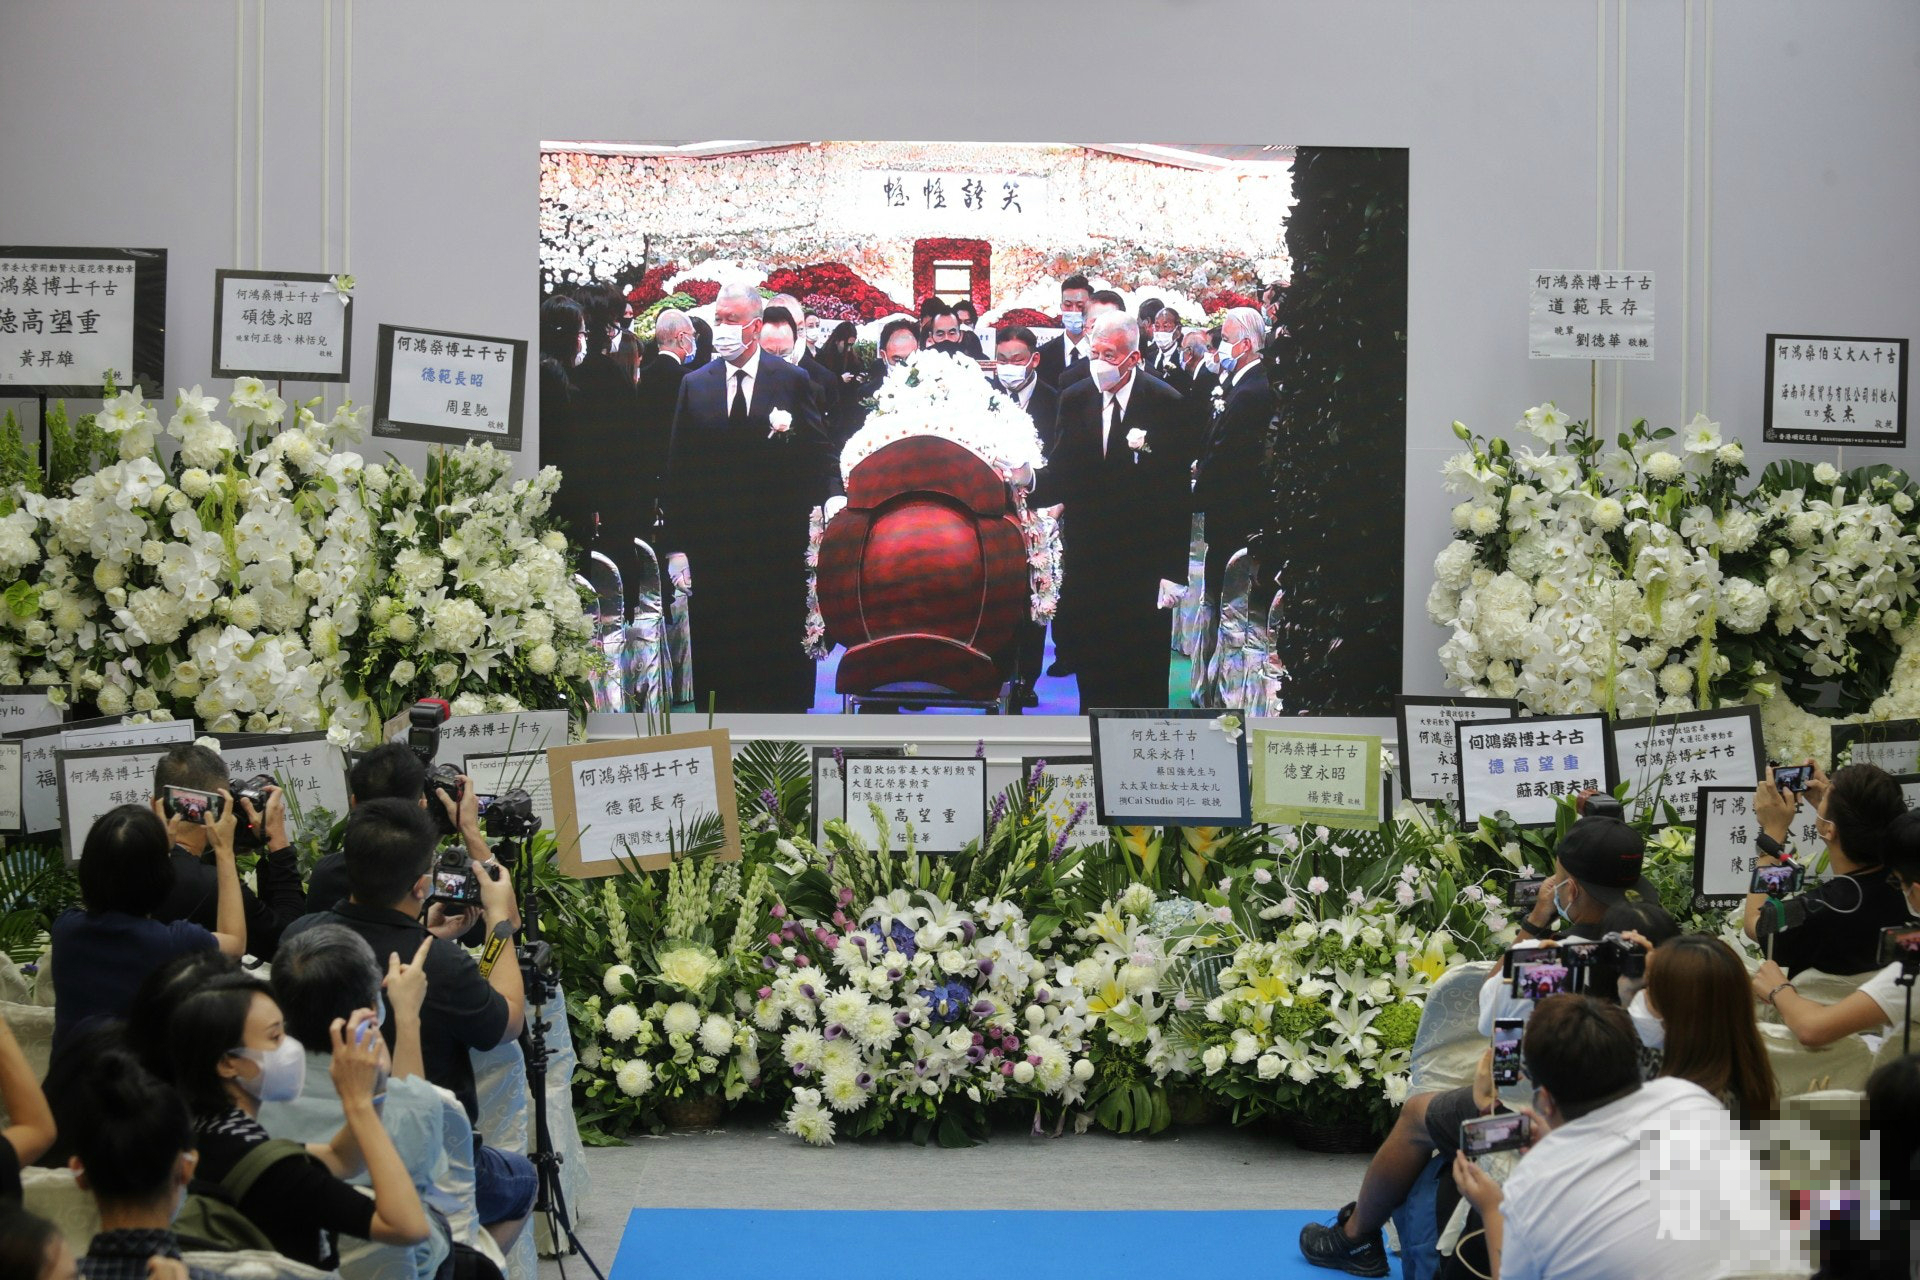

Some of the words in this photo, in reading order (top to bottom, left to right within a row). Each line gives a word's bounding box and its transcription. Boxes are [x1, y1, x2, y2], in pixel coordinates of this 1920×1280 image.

[1536, 274, 1652, 291] 何鴻燊博士千古
[1548, 297, 1638, 316] 道範長存
[0, 307, 101, 335] 德高望重
[241, 308, 312, 327] 碩德永昭
[1575, 333, 1621, 348] 劉德華
[19, 349, 75, 367] 黃昇雄
[421, 367, 484, 388] 德範長昭
[446, 399, 489, 417] 周星馳
[1131, 729, 1198, 742] 何先生千古
[225, 753, 312, 773] 鴻燊博士千古
[1284, 763, 1345, 781] 德望永昭
[1488, 754, 1579, 775] 德高望重
[605, 793, 686, 816] 德範長存
[870, 807, 956, 825] 高望重
